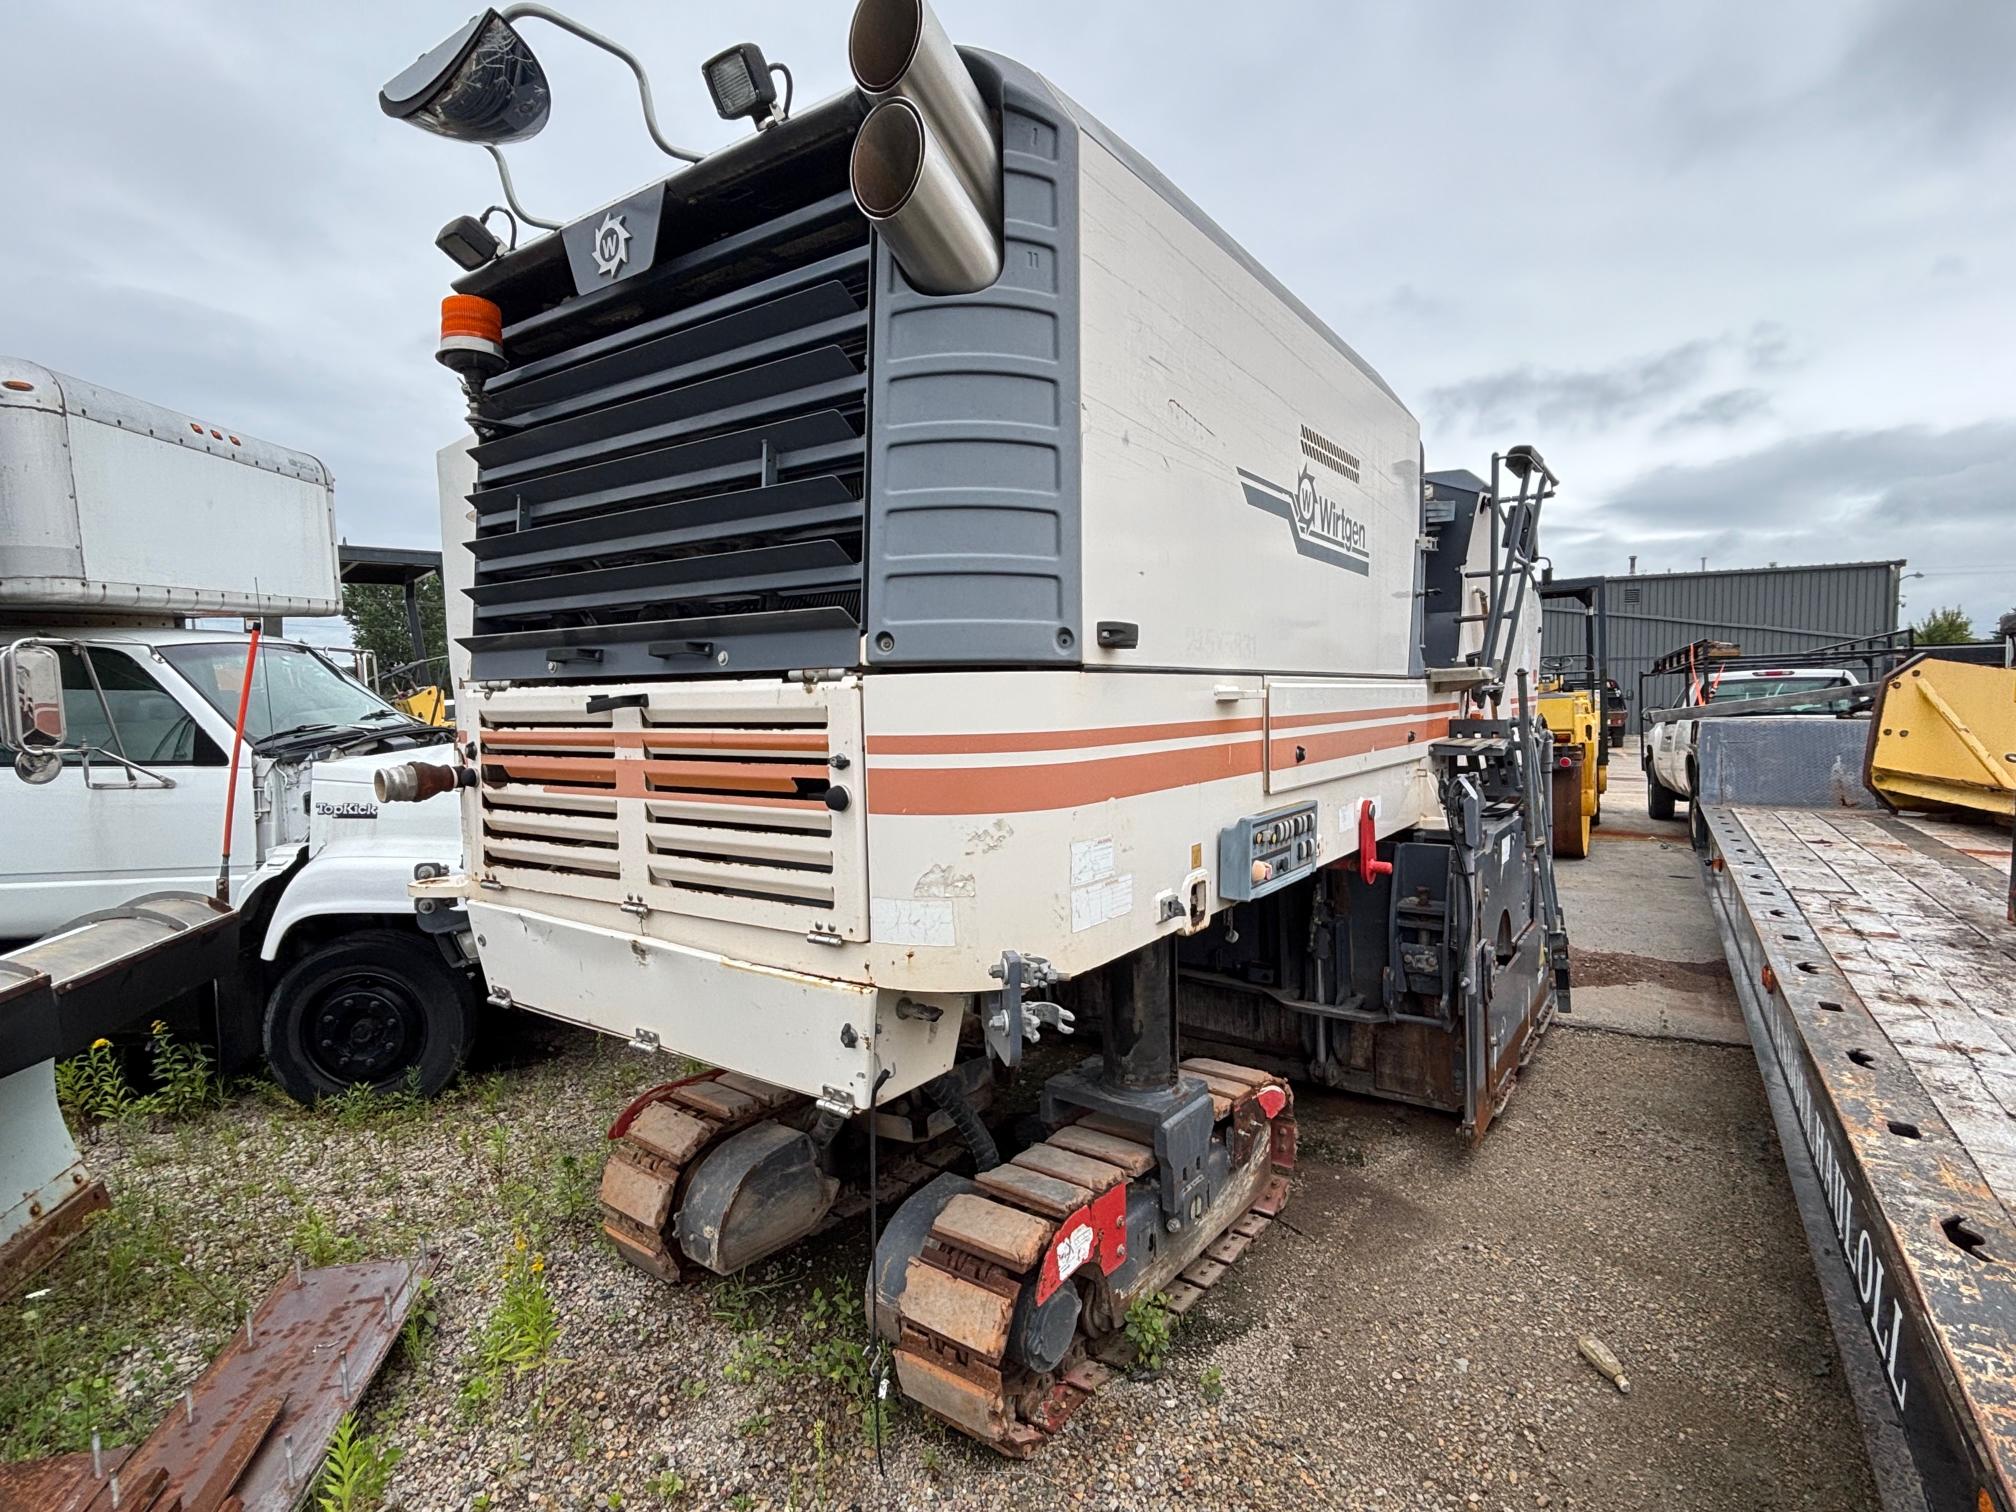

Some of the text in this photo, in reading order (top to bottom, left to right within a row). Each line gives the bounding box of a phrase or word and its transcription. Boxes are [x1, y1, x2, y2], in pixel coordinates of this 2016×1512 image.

[602, 234, 617, 259] W
[1301, 487, 1366, 552] W Wirtgen
[316, 801, 378, 818] TopKick
